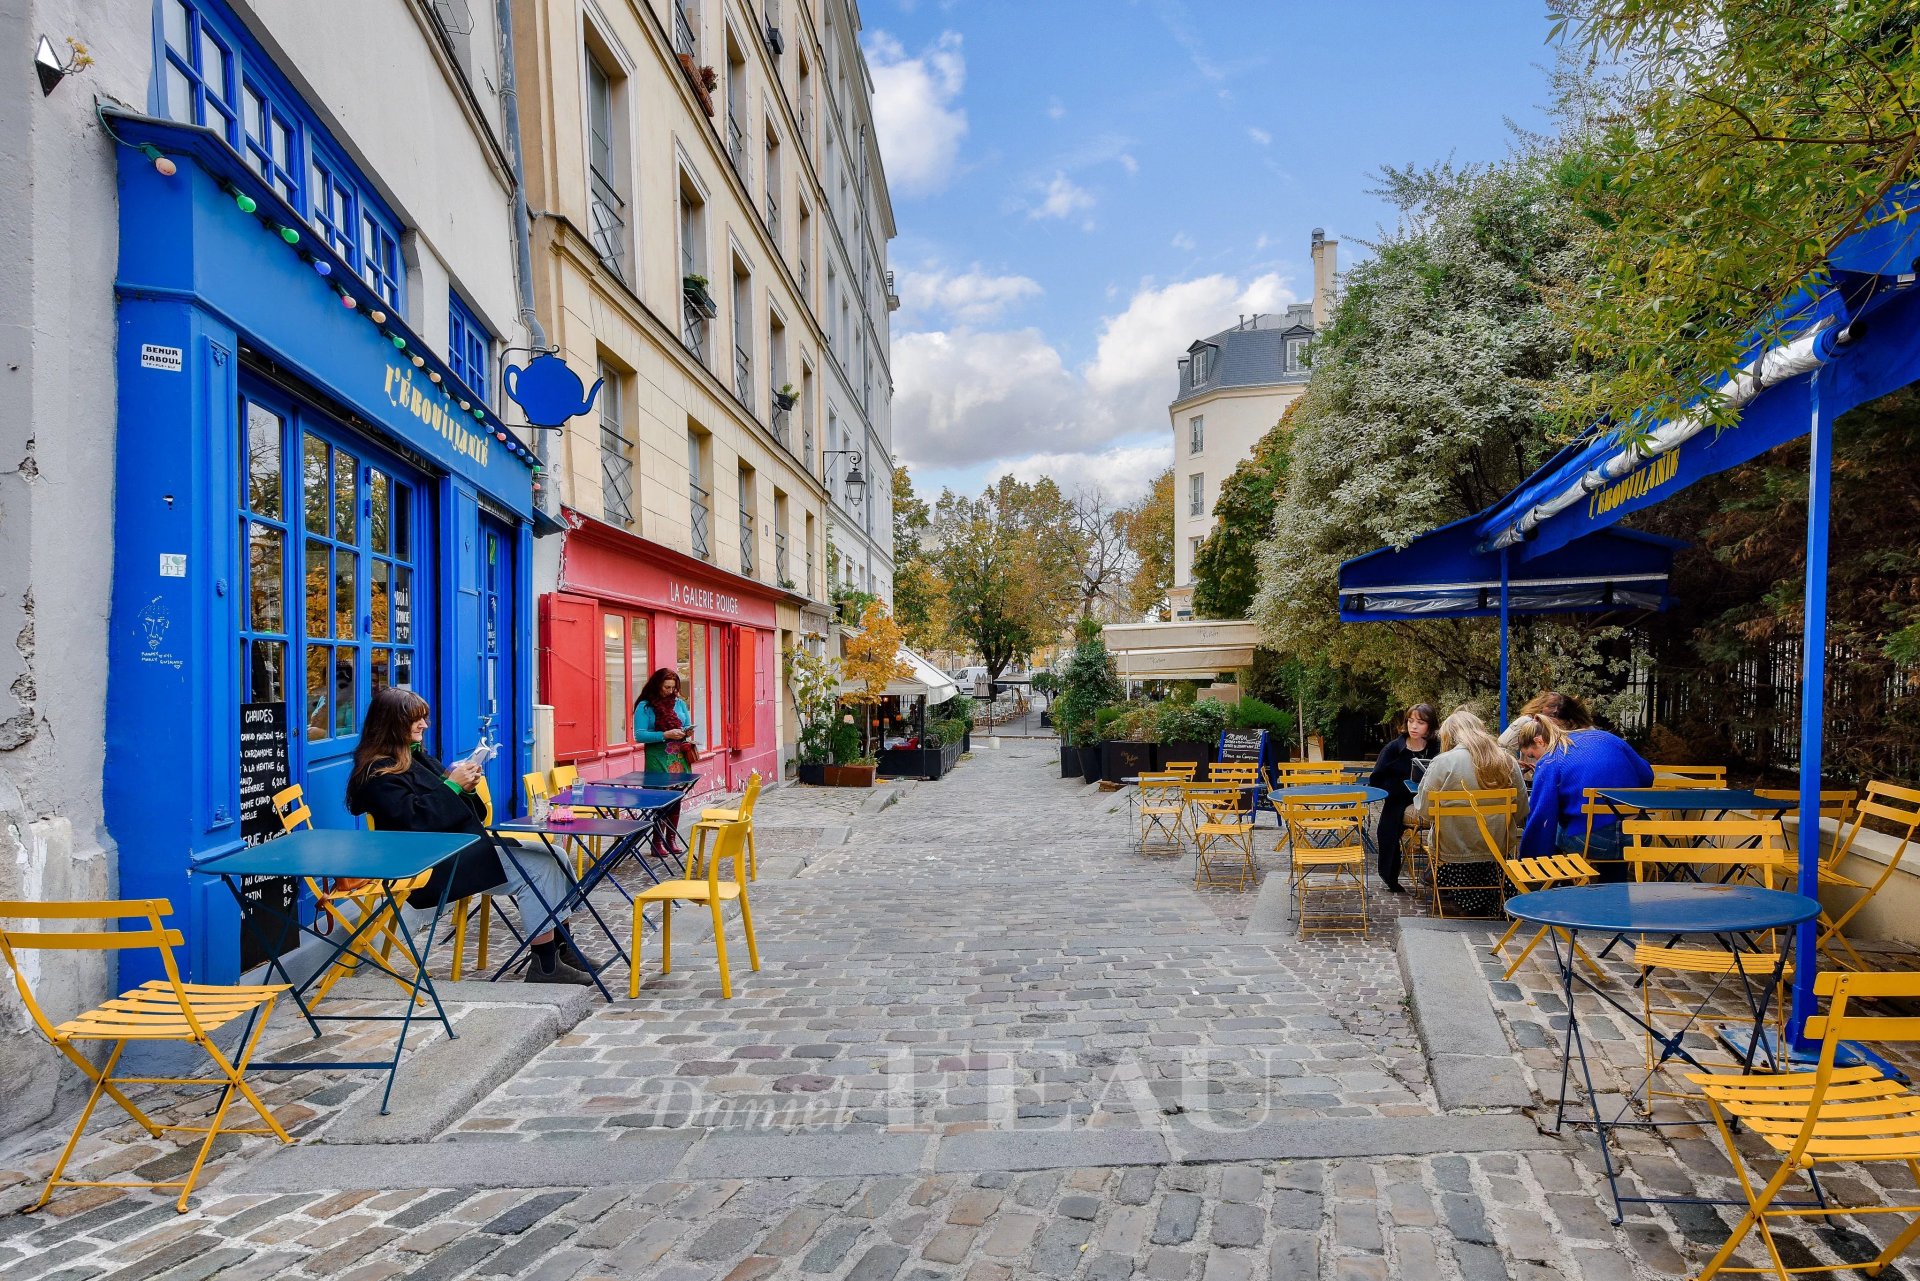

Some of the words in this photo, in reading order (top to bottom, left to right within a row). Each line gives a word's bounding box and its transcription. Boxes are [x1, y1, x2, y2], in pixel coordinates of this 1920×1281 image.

[146, 346, 178, 356] BENUR
[142, 354, 181, 365] DABOUL
[670, 581, 680, 602] LA
[682, 585, 714, 610] GALERIE
[715, 593, 739, 614] ROUGE
[245, 709, 274, 723] CHAUDES
[276, 761, 285, 773] 6€
